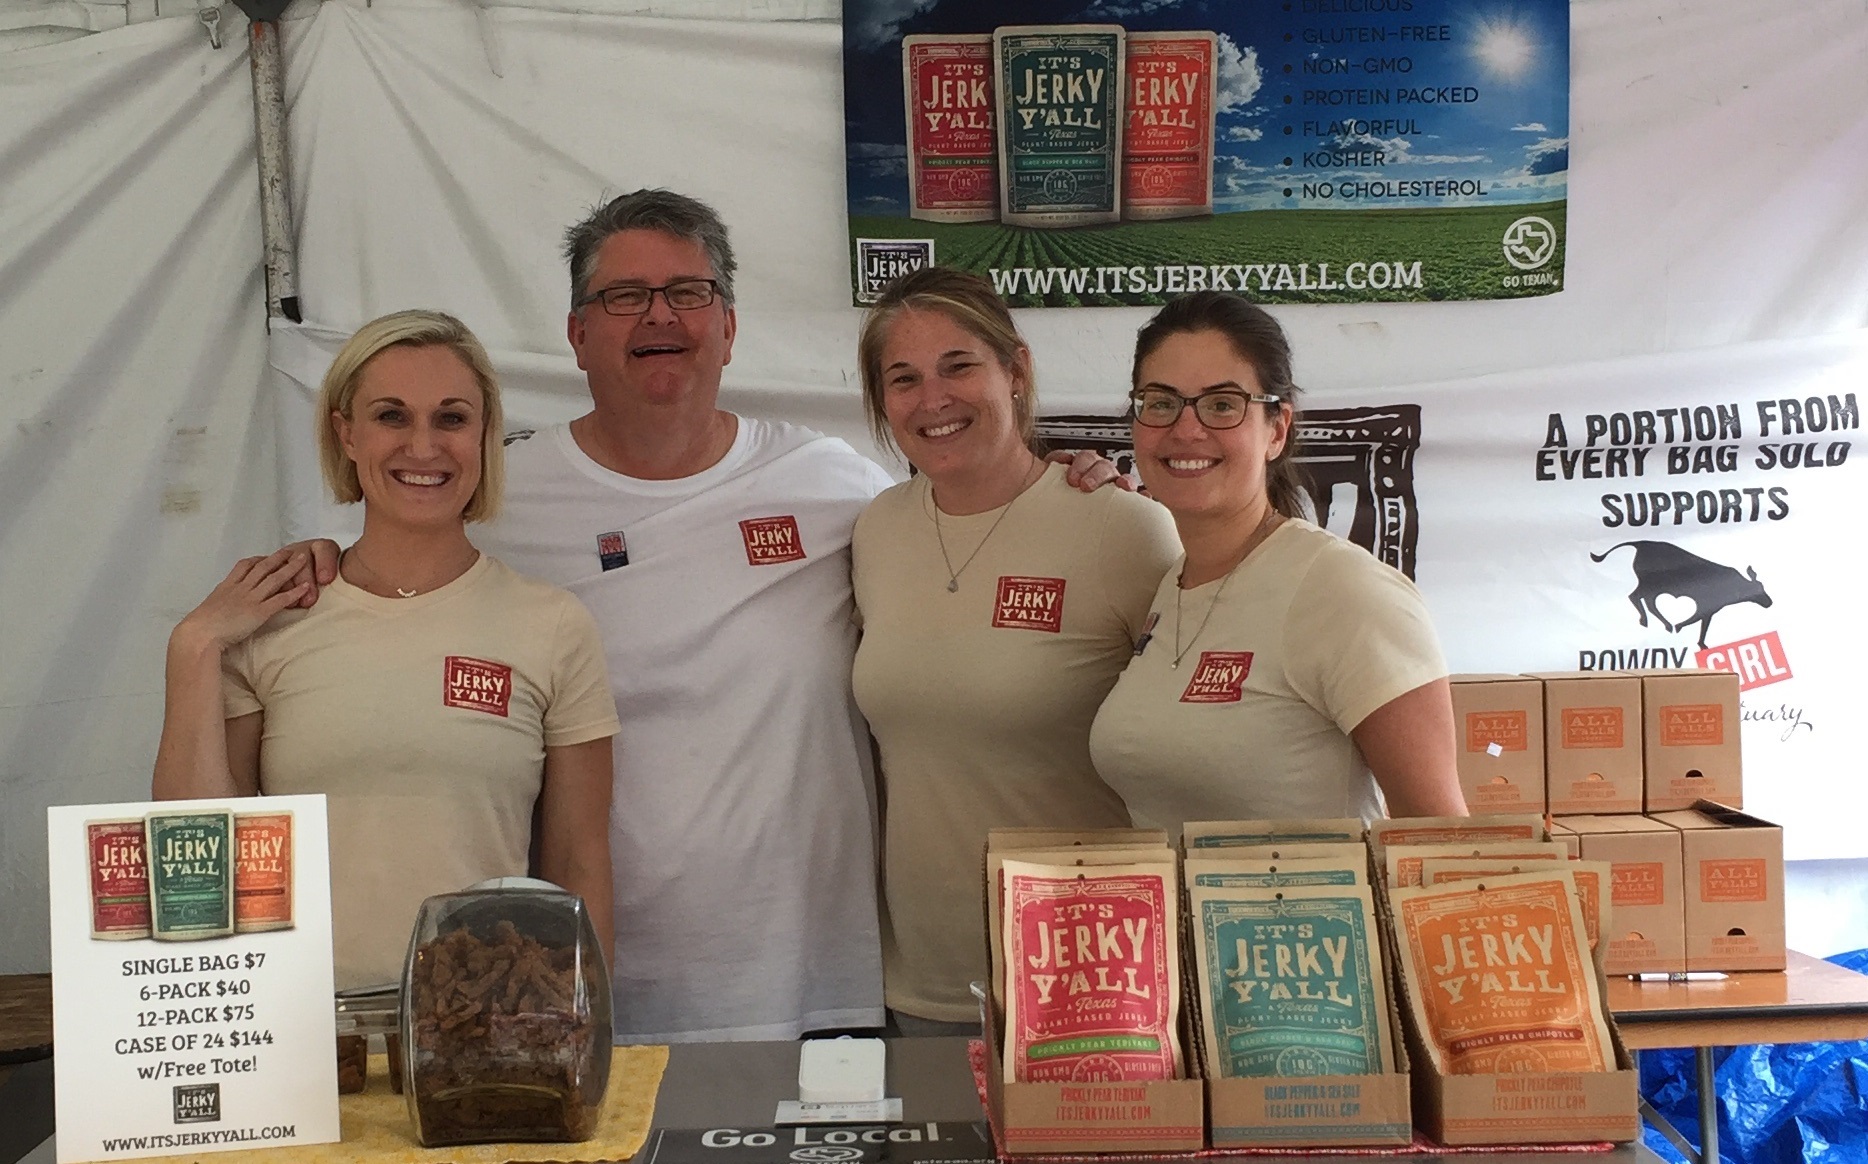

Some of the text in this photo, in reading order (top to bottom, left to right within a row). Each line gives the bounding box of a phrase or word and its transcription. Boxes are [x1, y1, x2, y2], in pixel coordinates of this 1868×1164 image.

[1302, 0, 1414, 14] DELICIOUS
[1302, 25, 1450, 44] GLUTEN-FREE
[944, 64, 984, 76] IT'S
[1038, 56, 1081, 70] IT'S
[1136, 61, 1176, 74] IT'S
[1303, 56, 1413, 74] NON-GMO
[923, 75, 995, 109] JERK
[1016, 68, 1104, 105] JERKY
[1303, 86, 1479, 106] PROTEIN PACKED
[1018, 108, 1101, 130] Y'ALL
[1303, 119, 1422, 137] FLAVORFUL
[1049, 129, 1078, 140] Texas
[1303, 150, 1385, 168] KOSHER
[1303, 180, 1488, 200] NO CHOLESTEROL
[989, 262, 1422, 294] WWW.ITSJERKYYALL.COM
[1503, 276, 1520, 288] GO
[1542, 393, 1860, 449] A PORTION FROM
[1536, 441, 1852, 482] EVERY BAG SOLD
[1600, 486, 1790, 528] SUPPORTS
[750, 527, 792, 546] JERKY
[752, 546, 798, 557] Y'ALL
[1002, 589, 1056, 610] JERKY
[1002, 608, 1054, 622] Y'ALL
[451, 670, 504, 693] JERKY
[1195, 665, 1243, 684] JERKY
[452, 688, 503, 706] Y'ALL
[1474, 719, 1519, 730] ALL
[1570, 716, 1616, 727] ALL
[1670, 713, 1715, 724] ALL
[1474, 731, 1519, 739] Y'ALLS
[1570, 727, 1615, 735] Y'ALLS
[176, 829, 204, 838] IT'S
[242, 830, 269, 839] IT'S
[98, 844, 146, 866] JERK
[161, 836, 220, 862] JERKY
[162, 861, 220, 878] Y'ALL
[1612, 872, 1655, 883] ALL
[1709, 867, 1758, 879] ALL
[1709, 880, 1758, 888] Y'ALLS
[1054, 904, 1114, 923] IT'S
[1254, 924, 1313, 939] IT'S
[1458, 914, 1518, 932] IT'S
[1028, 917, 1147, 969] JERKY
[1432, 924, 1553, 976] JERKY
[122, 952, 266, 976] SINGLE BAG $7
[1225, 936, 1347, 977] JERKY
[140, 979, 251, 1001] 6-PACK $40
[1030, 967, 1150, 1004] Y'ALL
[1228, 981, 1353, 1007] Y'ALL
[1438, 970, 1566, 1005] Y'ALL
[1075, 997, 1117, 1013] Texas
[1277, 1002, 1319, 1013] Texas
[1490, 995, 1532, 1009] Texas
[137, 1004, 254, 1027] 12-PACK $75
[1119, 1012, 1147, 1022] JERKY
[114, 1029, 274, 1055] CASE OF 24 $144
[137, 1056, 258, 1080] w/Free Tote!
[178, 1092, 216, 1108] JERKY
[180, 1108, 216, 1118] Y'ALL
[103, 1125, 296, 1152] WWW.ITSJERKYYALL.COM
[701, 1122, 953, 1148] Go Local.
